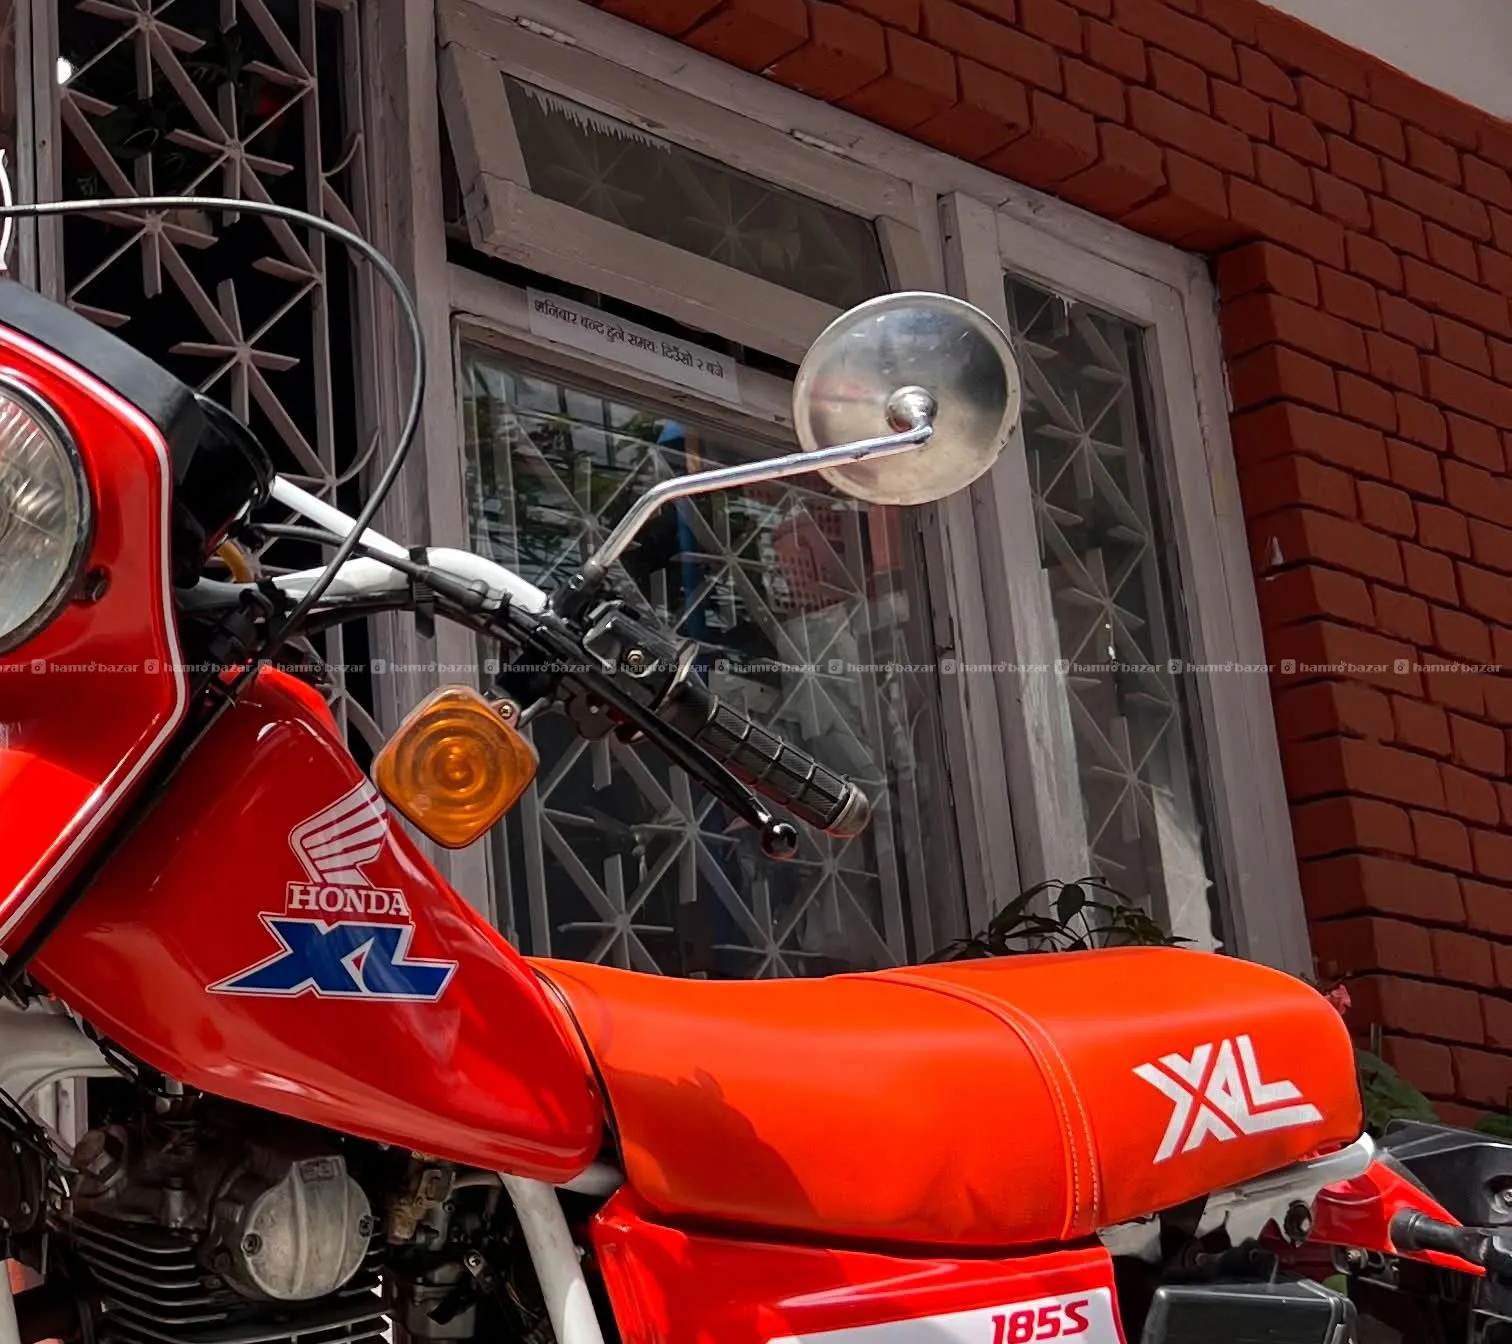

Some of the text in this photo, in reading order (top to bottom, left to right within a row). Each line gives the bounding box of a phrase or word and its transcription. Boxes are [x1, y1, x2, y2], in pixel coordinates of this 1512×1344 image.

[289, 885, 411, 916] HONDA
[206, 912, 459, 1002] XL
[1131, 1034, 1324, 1165] XL
